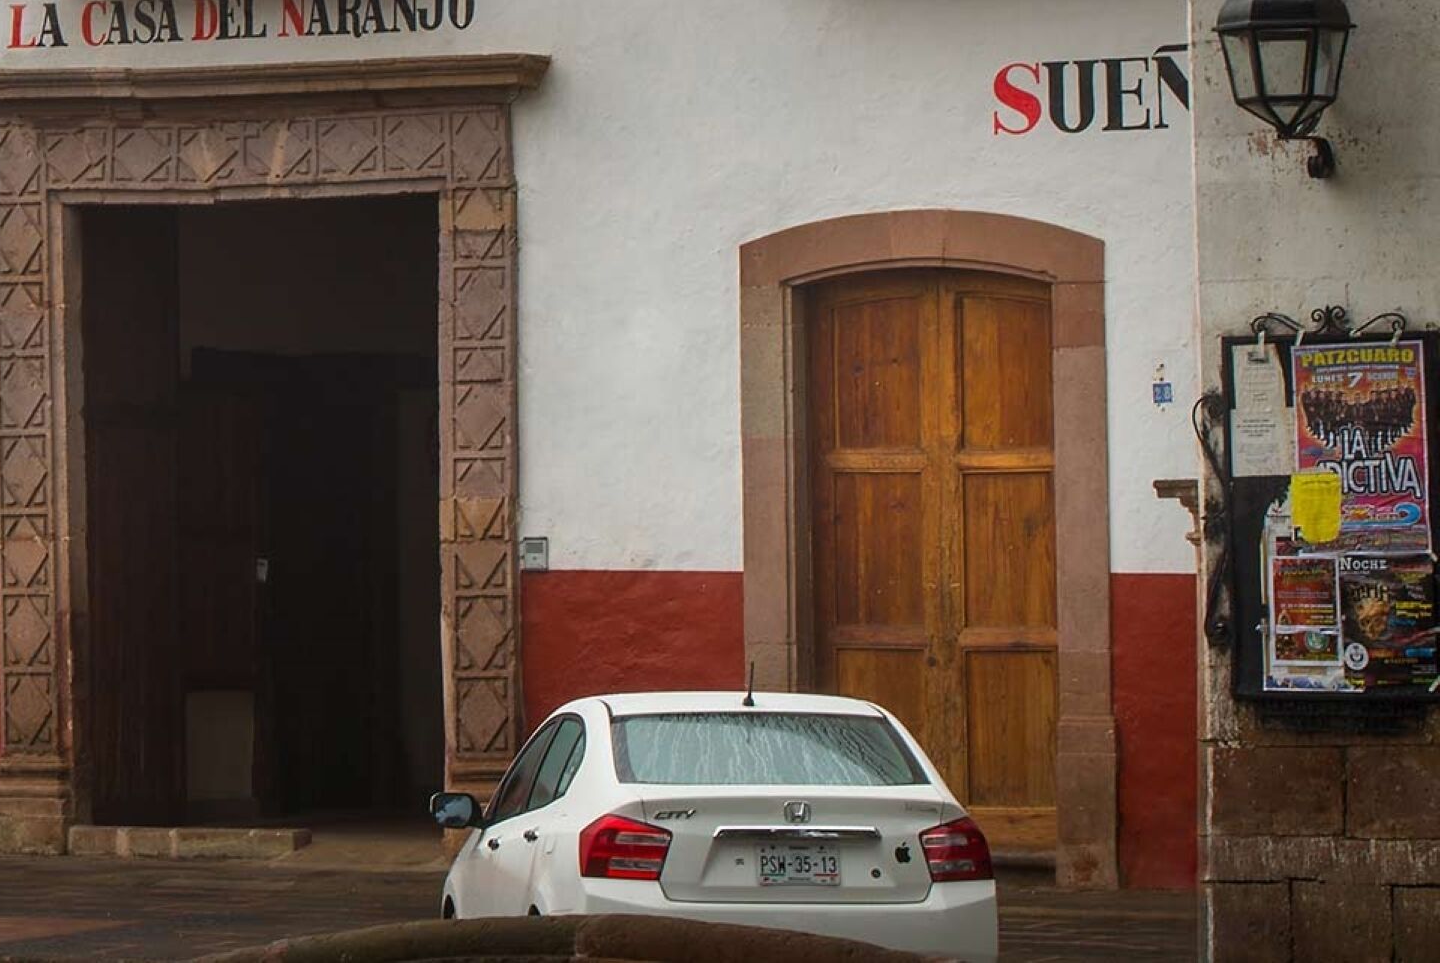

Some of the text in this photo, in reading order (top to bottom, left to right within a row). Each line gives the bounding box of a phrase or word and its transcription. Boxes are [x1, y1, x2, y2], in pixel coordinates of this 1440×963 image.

[6, 2, 68, 50] LA
[1301, 348, 1414, 367] PATZCUARO
[1317, 452, 1422, 499] DICTIVA
[1339, 557, 1388, 571] NOCHE
